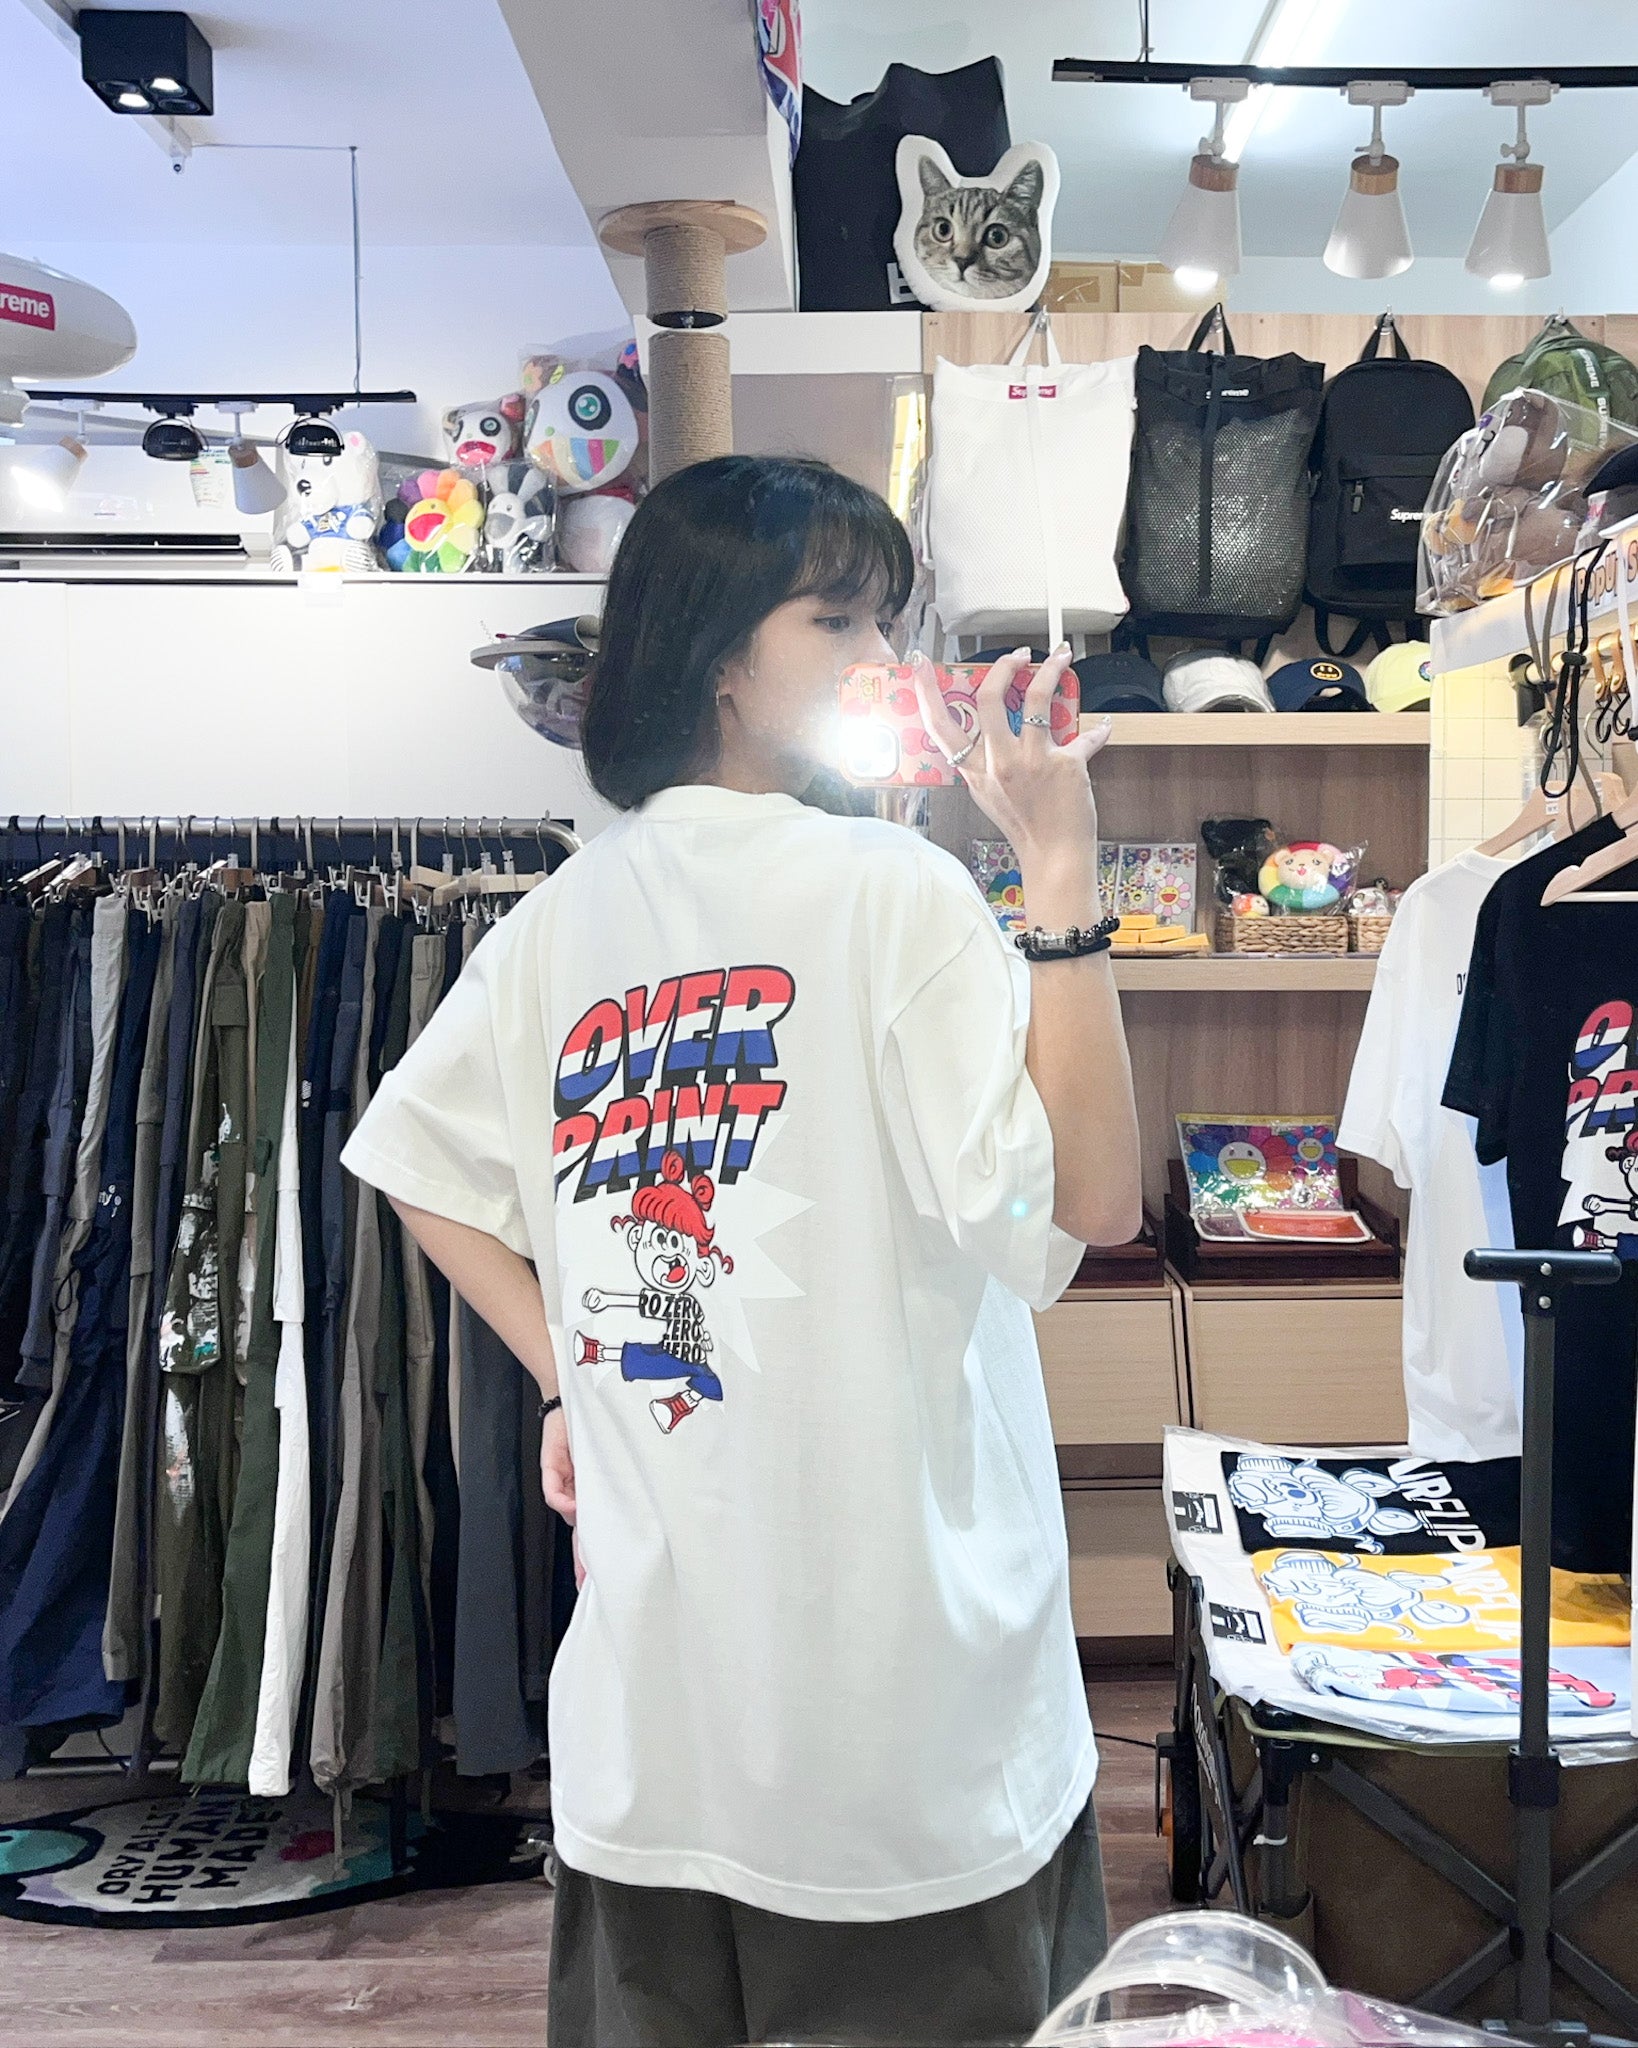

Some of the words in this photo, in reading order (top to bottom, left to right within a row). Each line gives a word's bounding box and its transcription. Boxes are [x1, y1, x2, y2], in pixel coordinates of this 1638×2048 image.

[554, 965, 796, 1118] OVER
[553, 1080, 787, 1204] PRINT
[662, 1296, 702, 1320] ZERO
[131, 1801, 237, 1904] HUMAN
[190, 1801, 284, 1888] MADE
